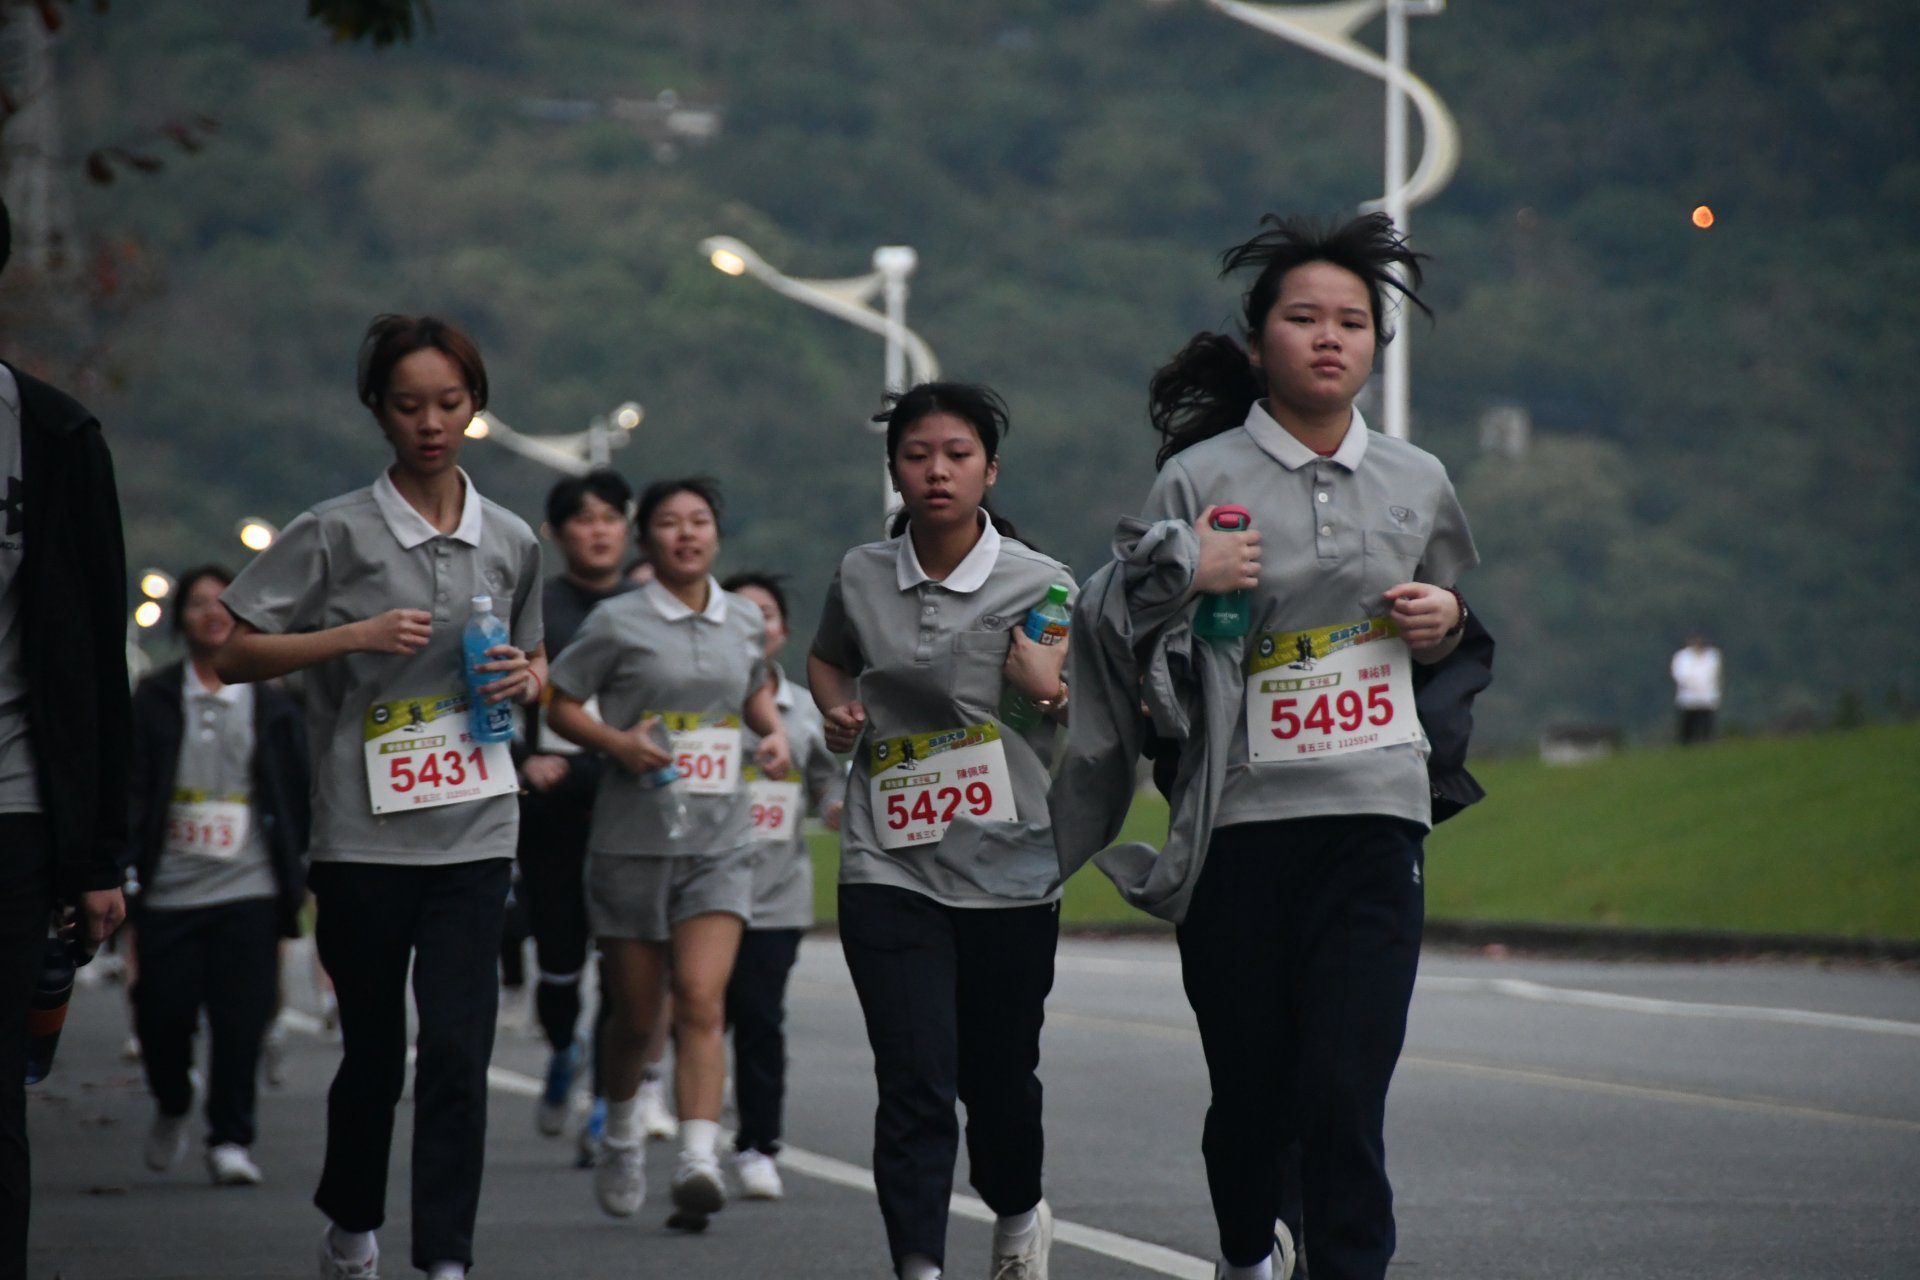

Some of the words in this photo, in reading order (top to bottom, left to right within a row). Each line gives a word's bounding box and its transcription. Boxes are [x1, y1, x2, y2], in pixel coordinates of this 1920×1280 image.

[1271, 683, 1394, 740] 5495
[390, 746, 489, 793] 5431
[887, 781, 993, 830] 5429
